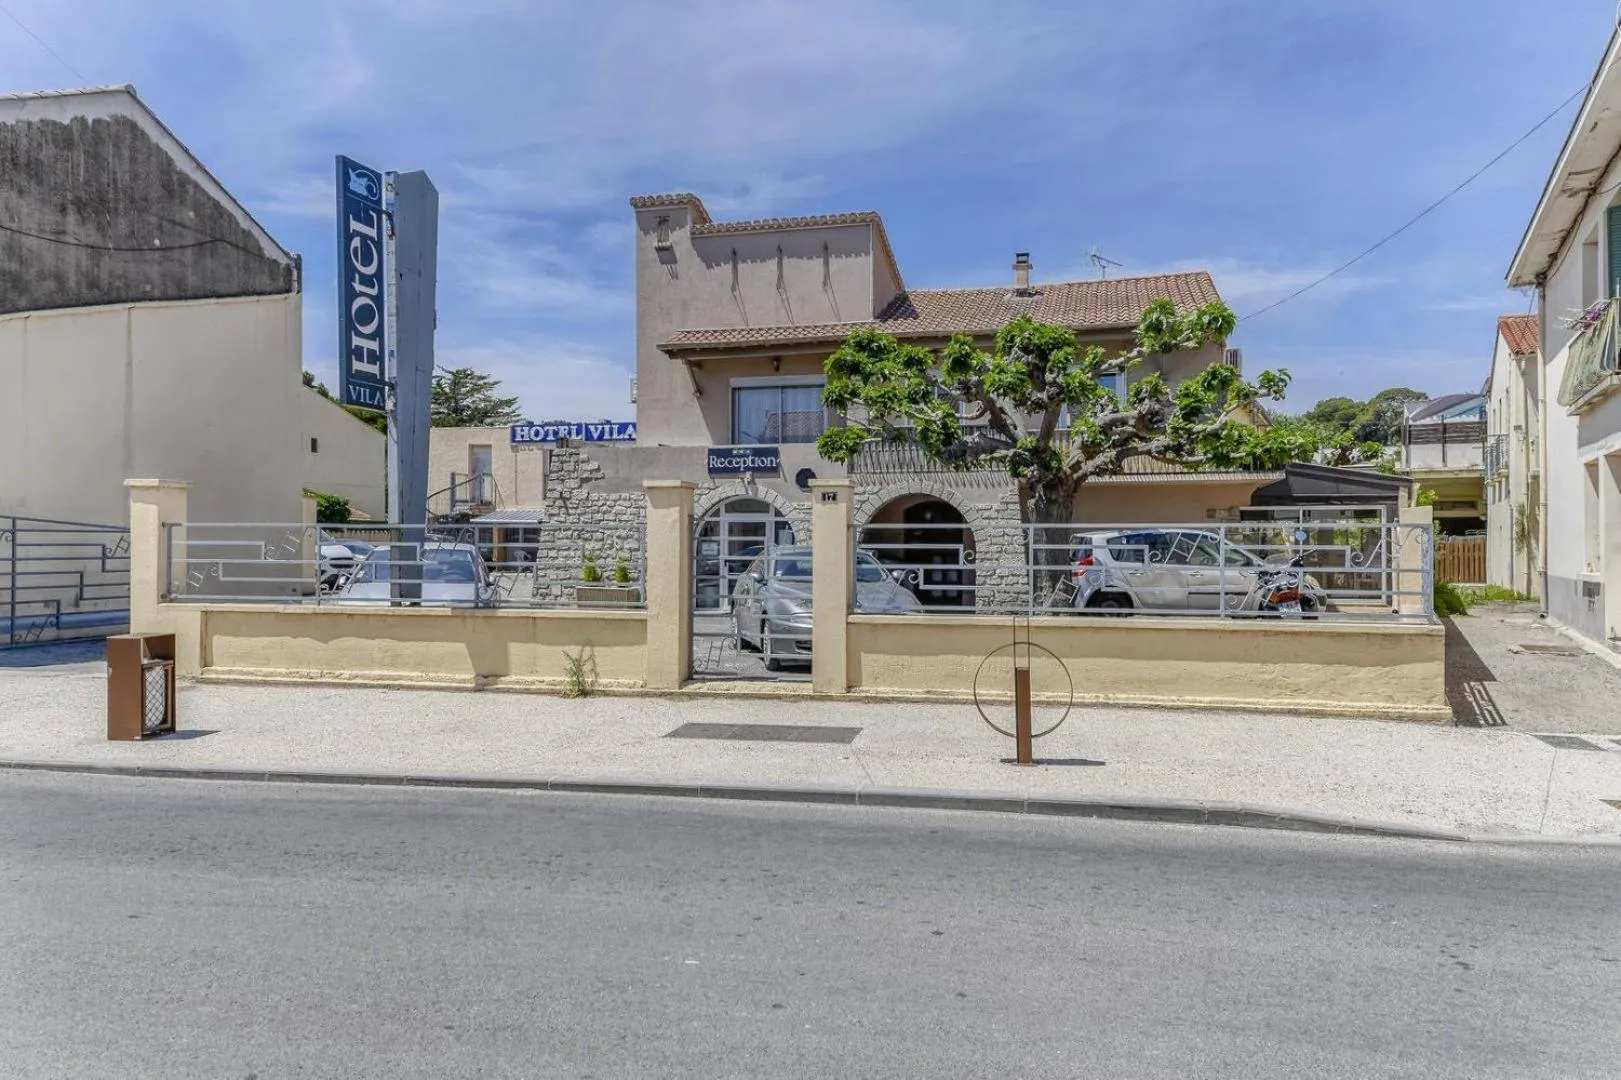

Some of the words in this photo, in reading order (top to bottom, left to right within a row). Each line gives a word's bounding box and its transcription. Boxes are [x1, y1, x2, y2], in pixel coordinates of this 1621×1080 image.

[348, 384, 384, 406] VILA
[514, 424, 582, 441] HOTEL
[588, 423, 637, 440] VILA
[709, 455, 777, 471] Reception
